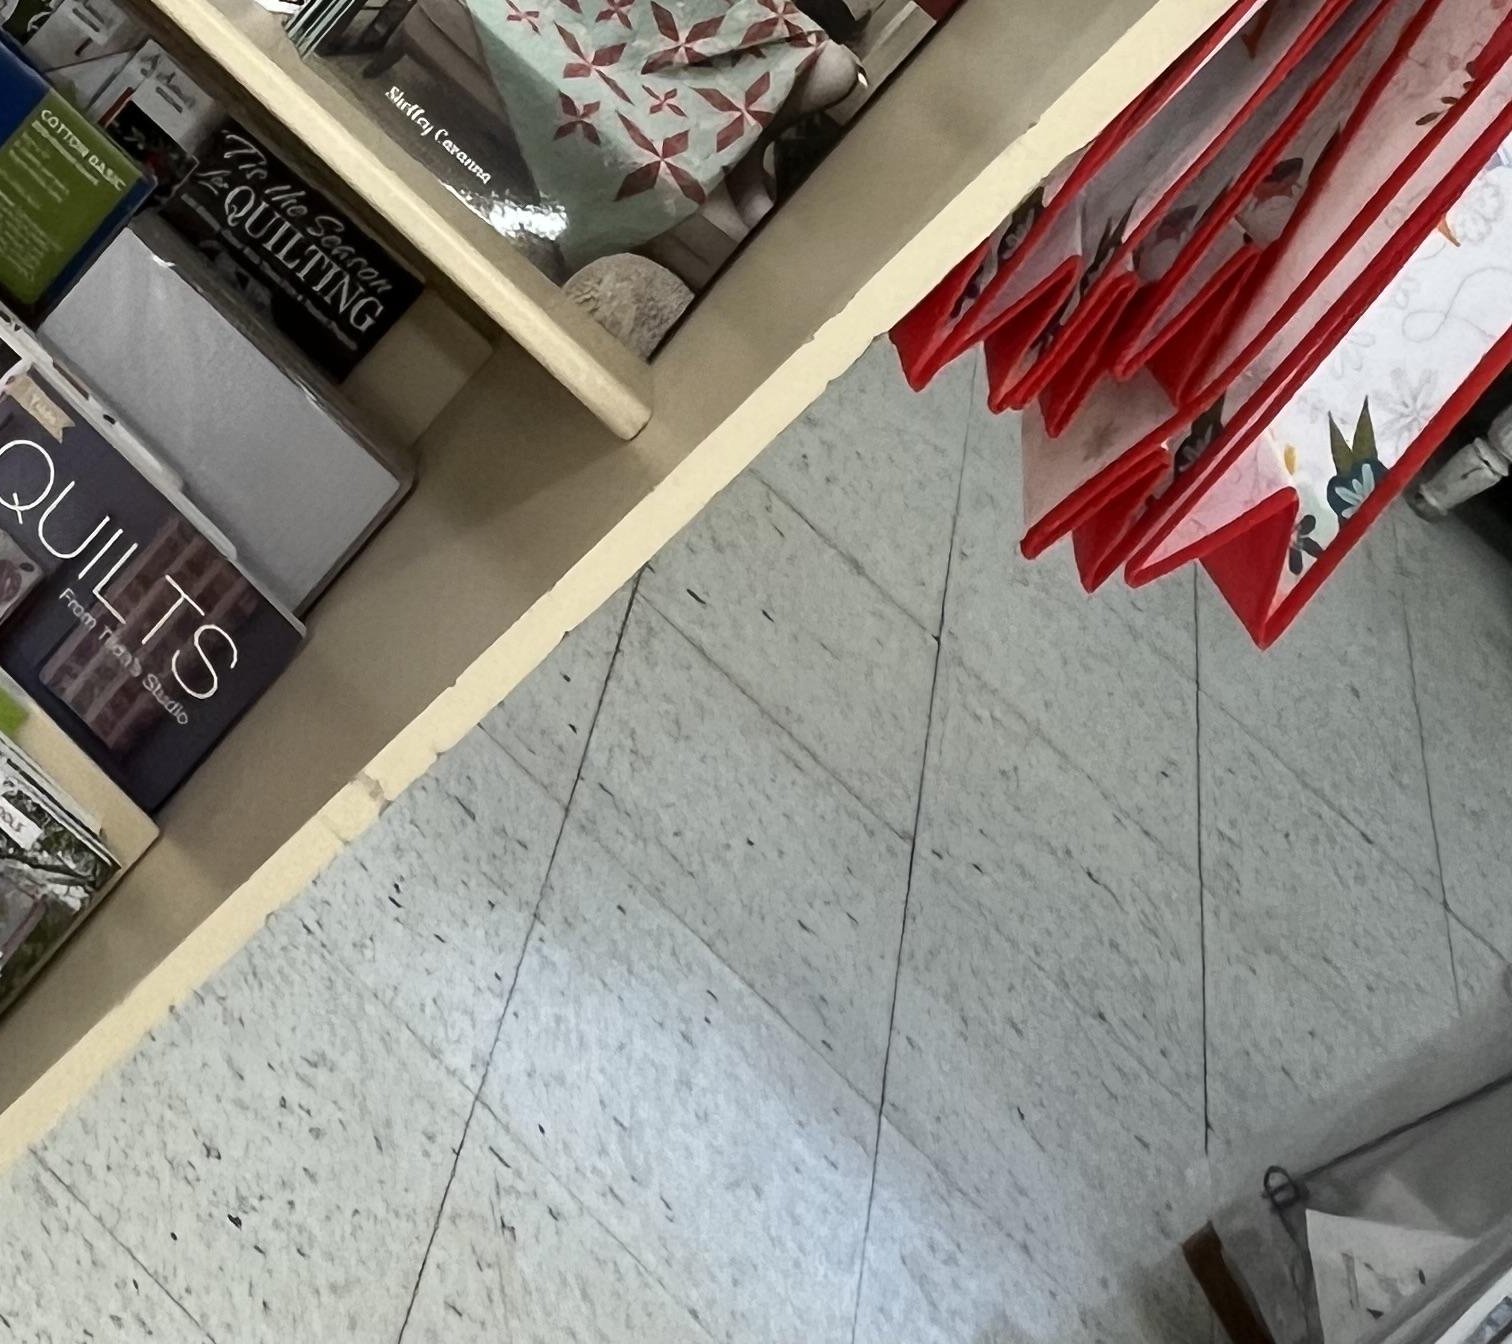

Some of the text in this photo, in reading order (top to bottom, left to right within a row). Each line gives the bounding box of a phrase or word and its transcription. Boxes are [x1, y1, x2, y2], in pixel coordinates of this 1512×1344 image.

[223, 184, 385, 333] QUILTING
[306, 214, 393, 294] Season
[59, 587, 97, 629] From
[141, 672, 189, 725] Studio
